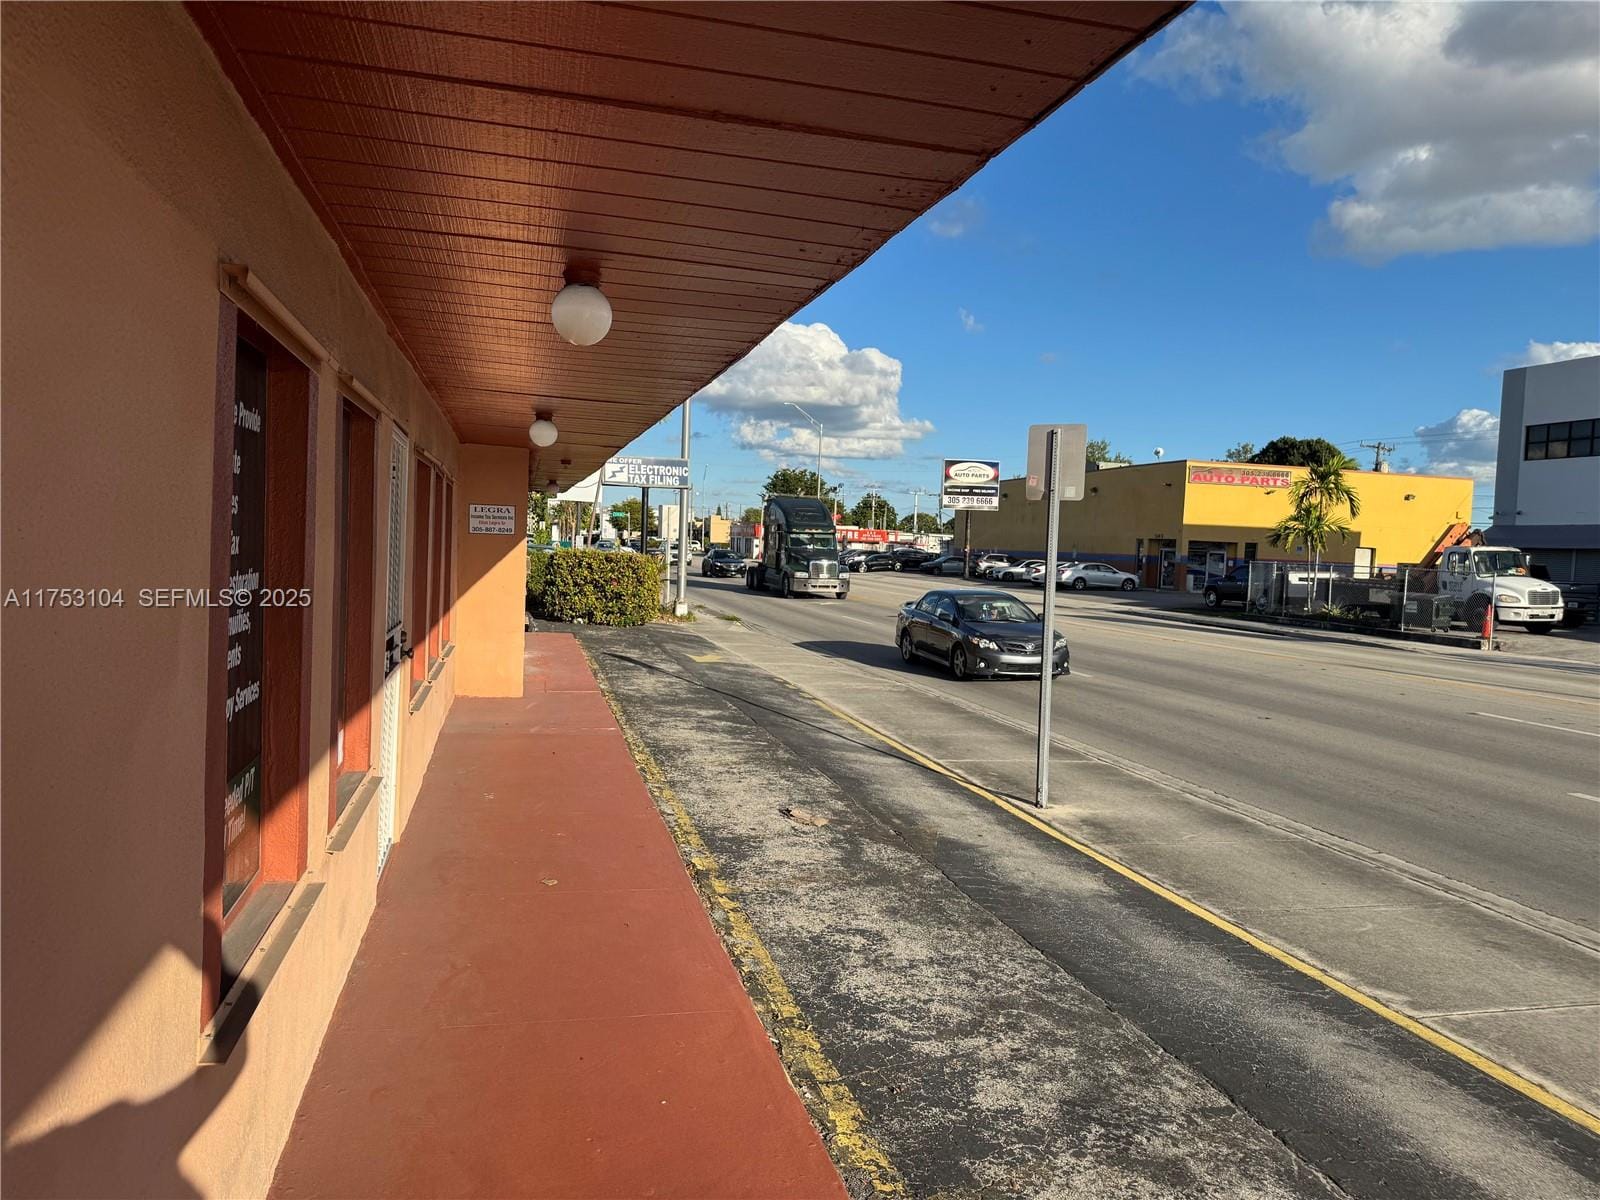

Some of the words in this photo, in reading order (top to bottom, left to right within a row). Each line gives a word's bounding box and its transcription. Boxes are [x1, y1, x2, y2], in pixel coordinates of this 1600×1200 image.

[238, 401, 261, 433] Provide
[629, 465, 688, 476] ELECTRONIC
[629, 475, 647, 484] TAX
[649, 476, 679, 485] FILING
[1192, 473, 1235, 483] AUTO
[1241, 476, 1289, 487] PARTS
[947, 496, 960, 504] 305
[474, 506, 511, 514] LEGRA
[235, 680, 260, 712] Services
